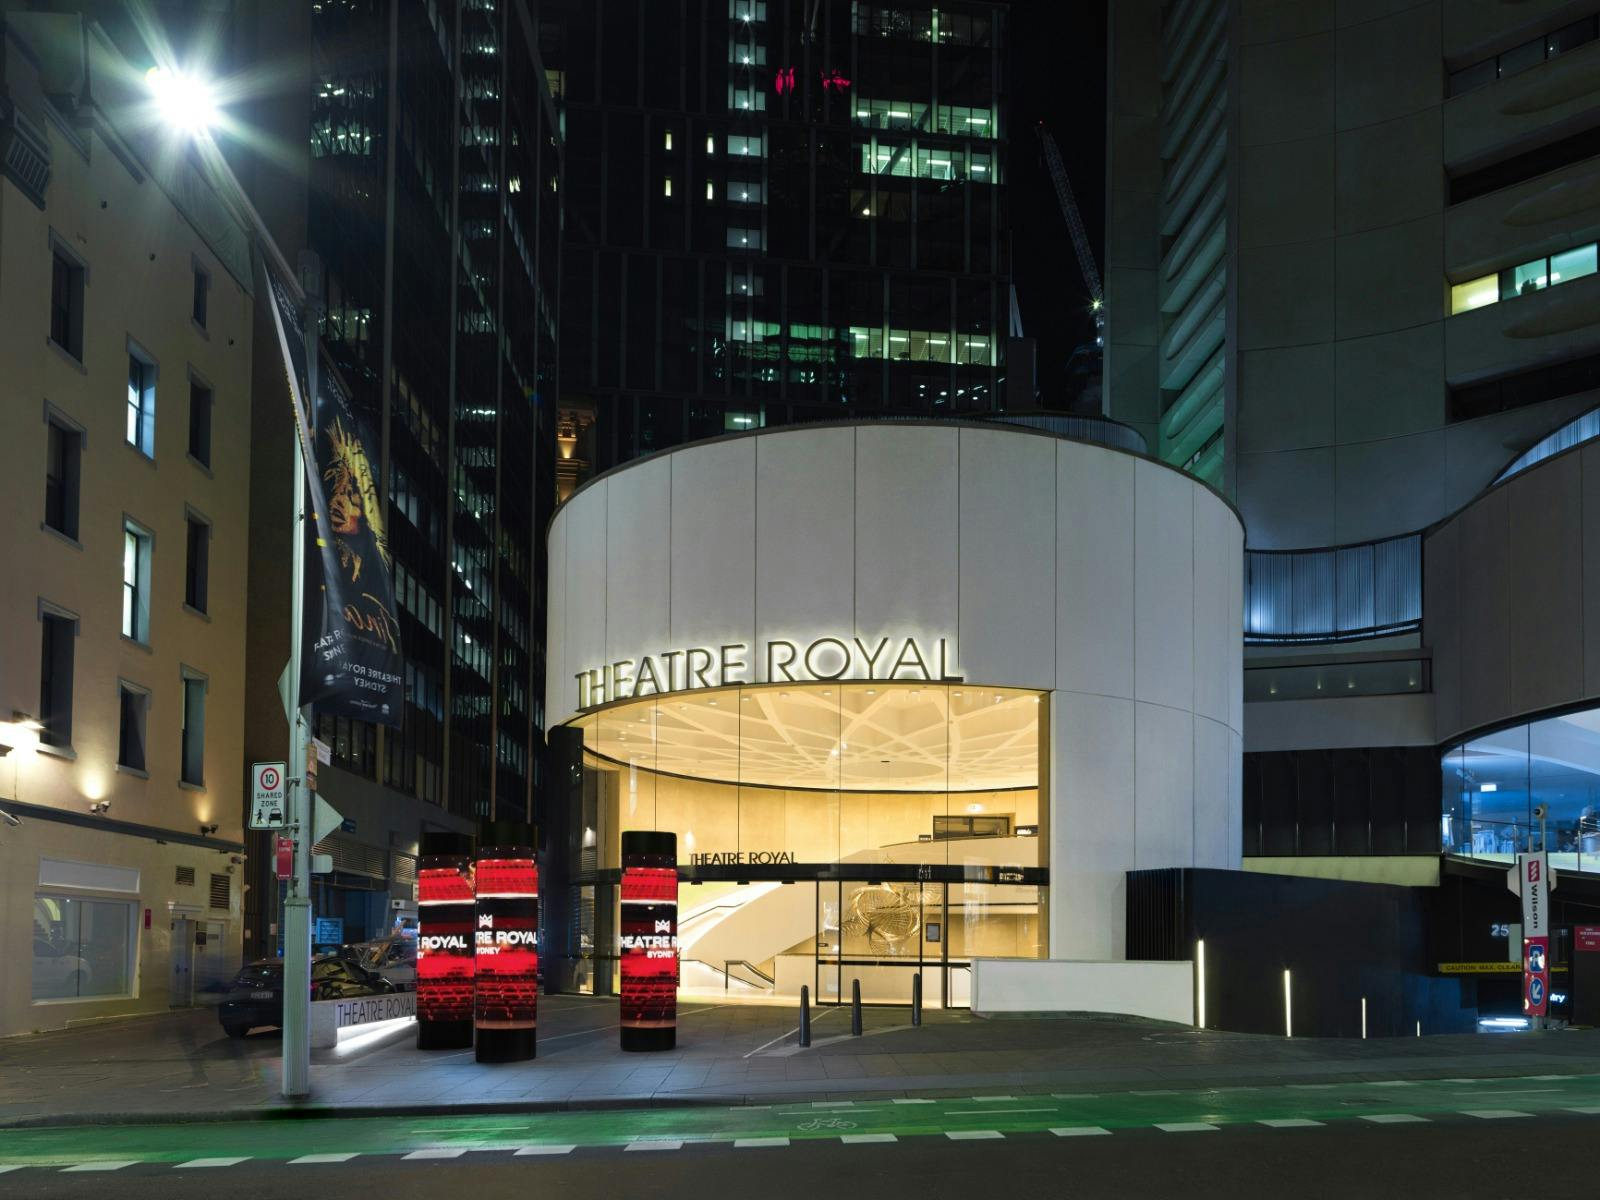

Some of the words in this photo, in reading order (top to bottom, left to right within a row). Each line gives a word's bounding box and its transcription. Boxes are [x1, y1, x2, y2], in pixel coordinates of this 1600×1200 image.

[574, 643, 748, 711] THEATRE
[767, 637, 964, 683] ROYAL
[265, 773, 275, 784] 10
[256, 791, 283, 800] SHARED
[260, 799, 279, 807] ZONE
[688, 851, 744, 865] THEATRE
[748, 851, 799, 864] ROYAL
[1530, 884, 1539, 929] Wilson
[1490, 924, 1510, 937] 25
[421, 935, 468, 949] ROYAL
[495, 931, 538, 945] ROYAL
[646, 950, 674, 959] SYDNEY
[337, 1000, 383, 1026] THEATRE
[386, 996, 416, 1019] ROYAL
